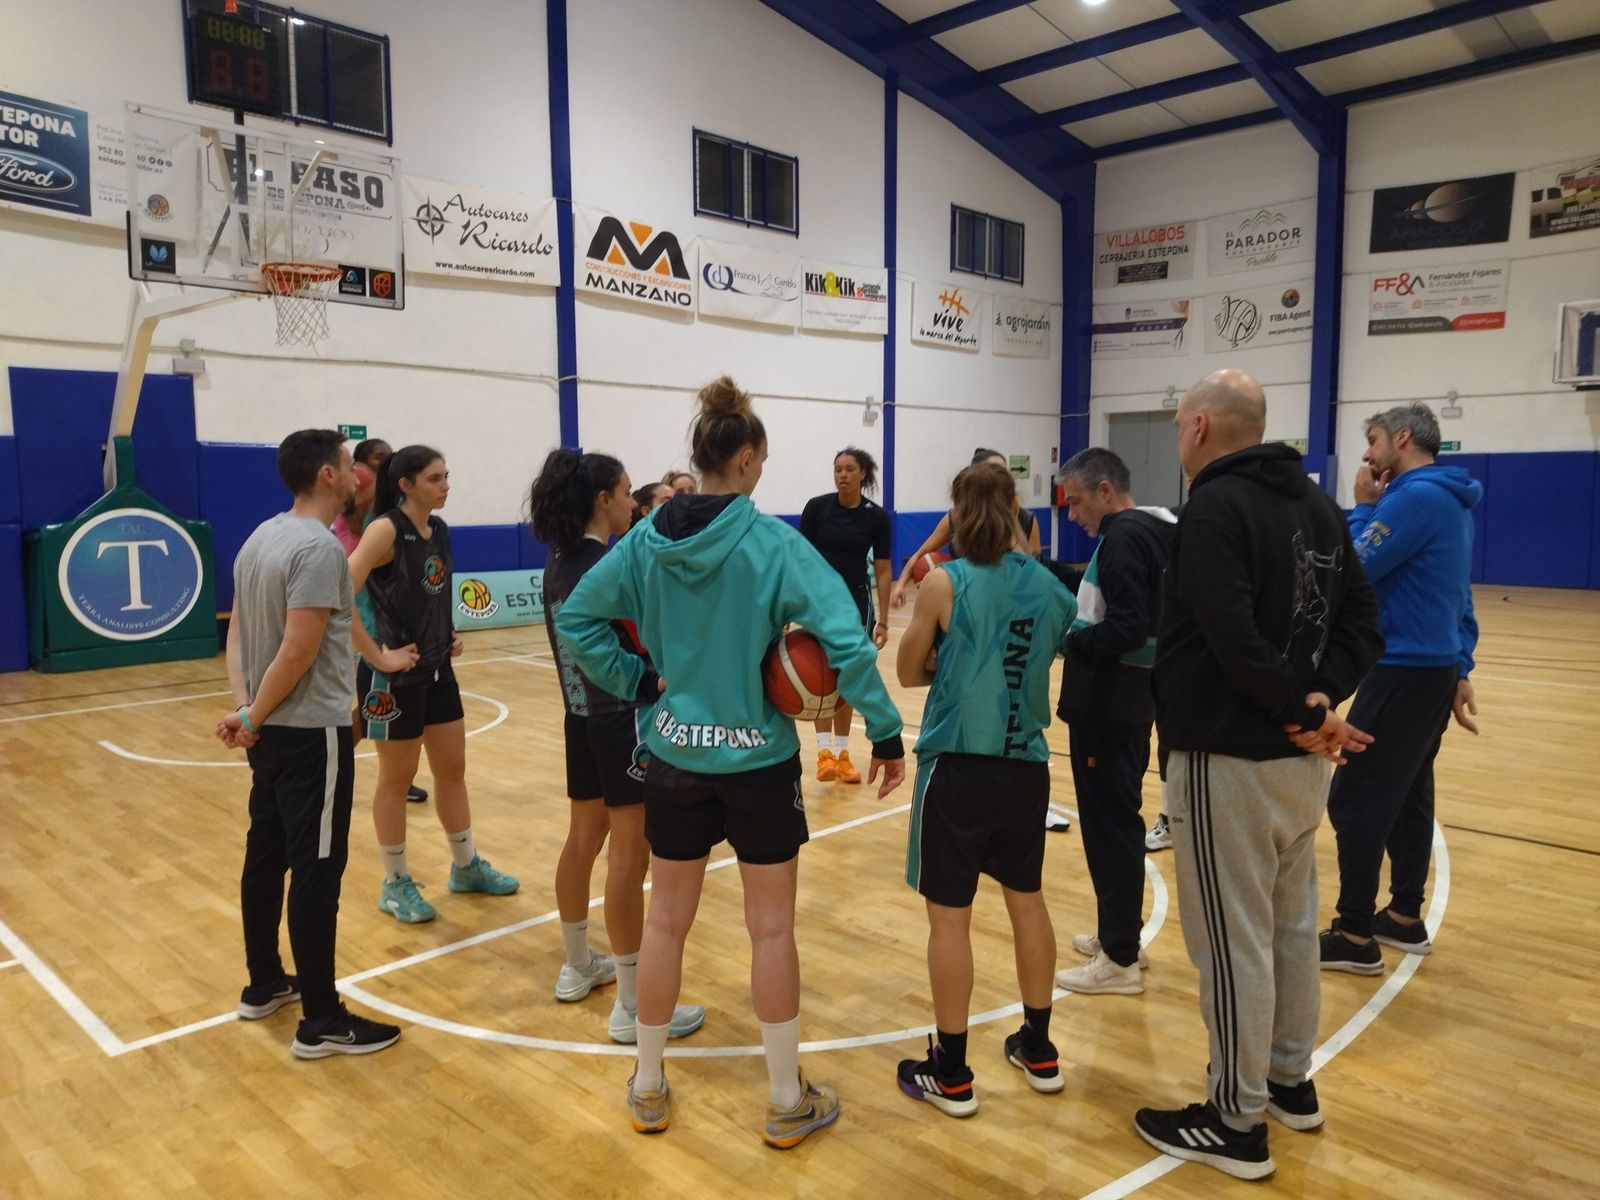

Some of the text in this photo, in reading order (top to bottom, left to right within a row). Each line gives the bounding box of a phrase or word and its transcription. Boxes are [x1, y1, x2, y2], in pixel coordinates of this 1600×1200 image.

[291, 161, 384, 208] PASO
[443, 193, 529, 224] Autocares
[459, 219, 554, 255] Ricardo
[1106, 225, 1185, 249] VILLALOBOS
[1226, 227, 1302, 251] PARADOR
[1147, 245, 1190, 259] ESTEPONA
[435, 261, 535, 278] www.autocaresricardo.com
[585, 272, 692, 306] MANZANO
[1270, 310, 1311, 323] FIBA Agent
